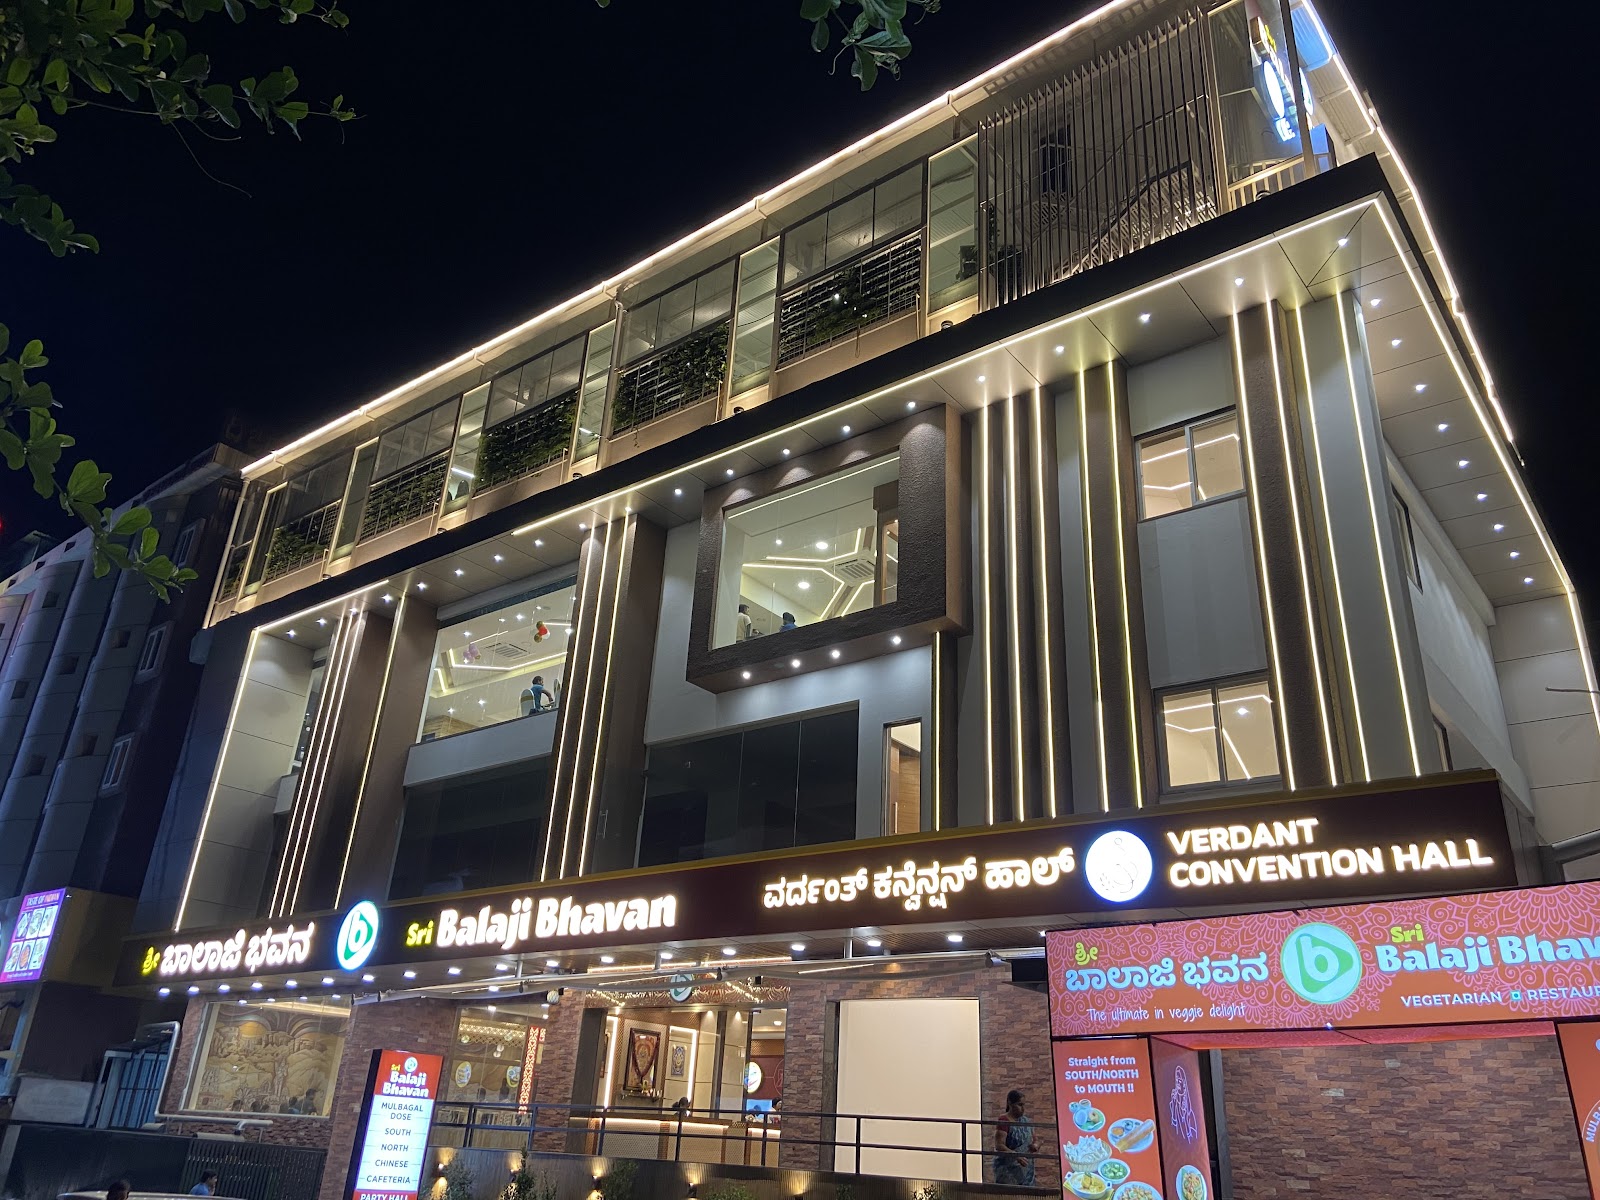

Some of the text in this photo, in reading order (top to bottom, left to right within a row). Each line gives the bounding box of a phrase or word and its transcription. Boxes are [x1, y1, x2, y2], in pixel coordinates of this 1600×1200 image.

[1167, 818, 1318, 855] VERDANT
[985, 847, 1075, 889] ಹಾಲ್
[1169, 839, 1493, 887] CONVENTION HALL
[406, 894, 676, 950] Sri Balaji Bhavan
[1390, 923, 1424, 943] Sri
[160, 929, 247, 975] ಬಾಲಾಜಿ
[245, 921, 315, 972] ಭವನ
[1075, 942, 1098, 965] ಶ್ರೀ
[1375, 933, 1600, 973] Balaji Bhav
[1065, 951, 1269, 991] ಬಾಲಾಜಿ ಭವನ
[1401, 991, 1502, 1007] VEGETARIAN
[1086, 1003, 1246, 1022] The ultimate in veggie delight
[1068, 1056, 1136, 1068] Straight from
[390, 1071, 427, 1086] Balaji
[1065, 1069, 1139, 1080] SOUTH/NORTH
[382, 1082, 429, 1097] Bhavan
[1074, 1084, 1085, 1093] to
[1088, 1083, 1125, 1093] MOUTH
[381, 1102, 423, 1112] MULBAGAL
[390, 1112, 412, 1121] DOSE
[384, 1128, 411, 1136] SOUTH
[381, 1144, 409, 1152] NORTH
[375, 1160, 409, 1168] CHINESE
[366, 1175, 411, 1184] CAFETERIA
